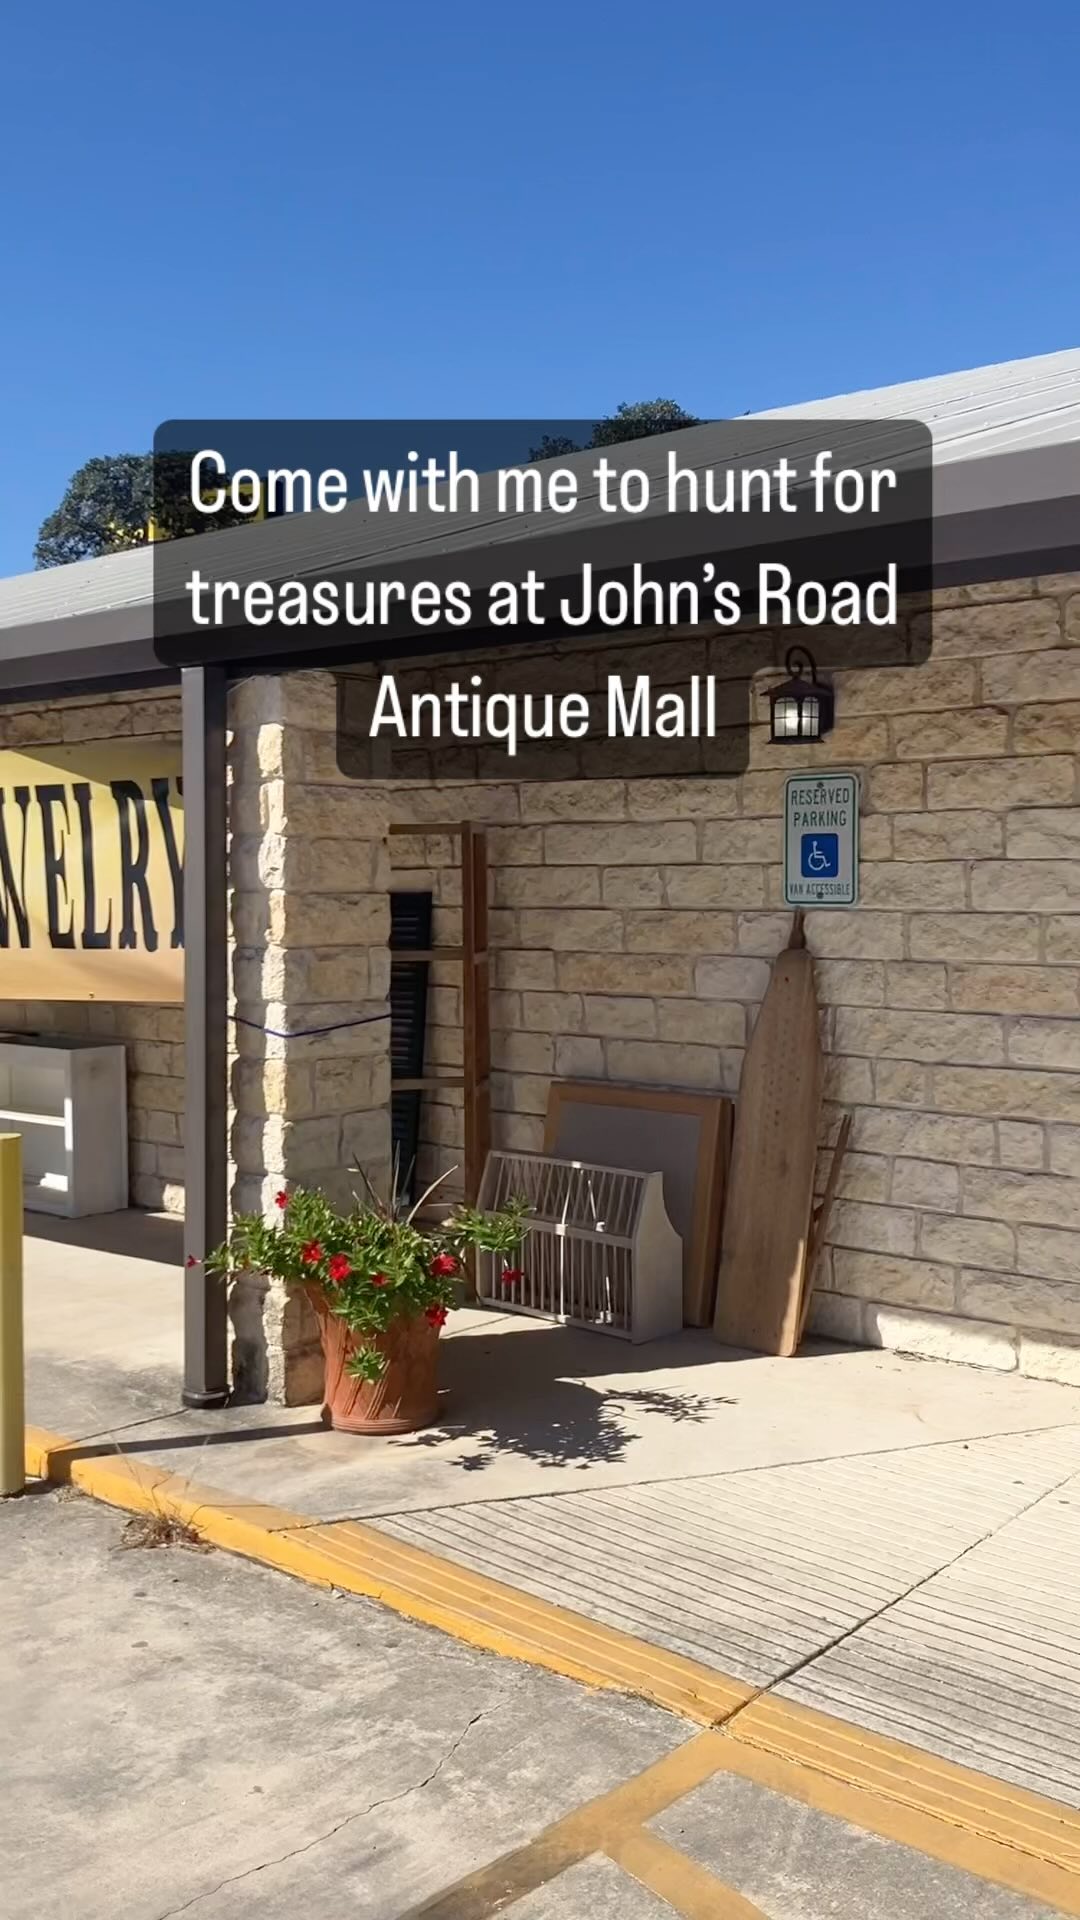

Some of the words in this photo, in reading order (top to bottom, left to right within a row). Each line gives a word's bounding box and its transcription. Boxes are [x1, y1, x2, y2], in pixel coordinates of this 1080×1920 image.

[791, 787, 850, 806] RESERVED
[793, 810, 847, 827] PARKING
[789, 883, 804, 896] VAN
[806, 882, 850, 896] ACCESSIBLE
